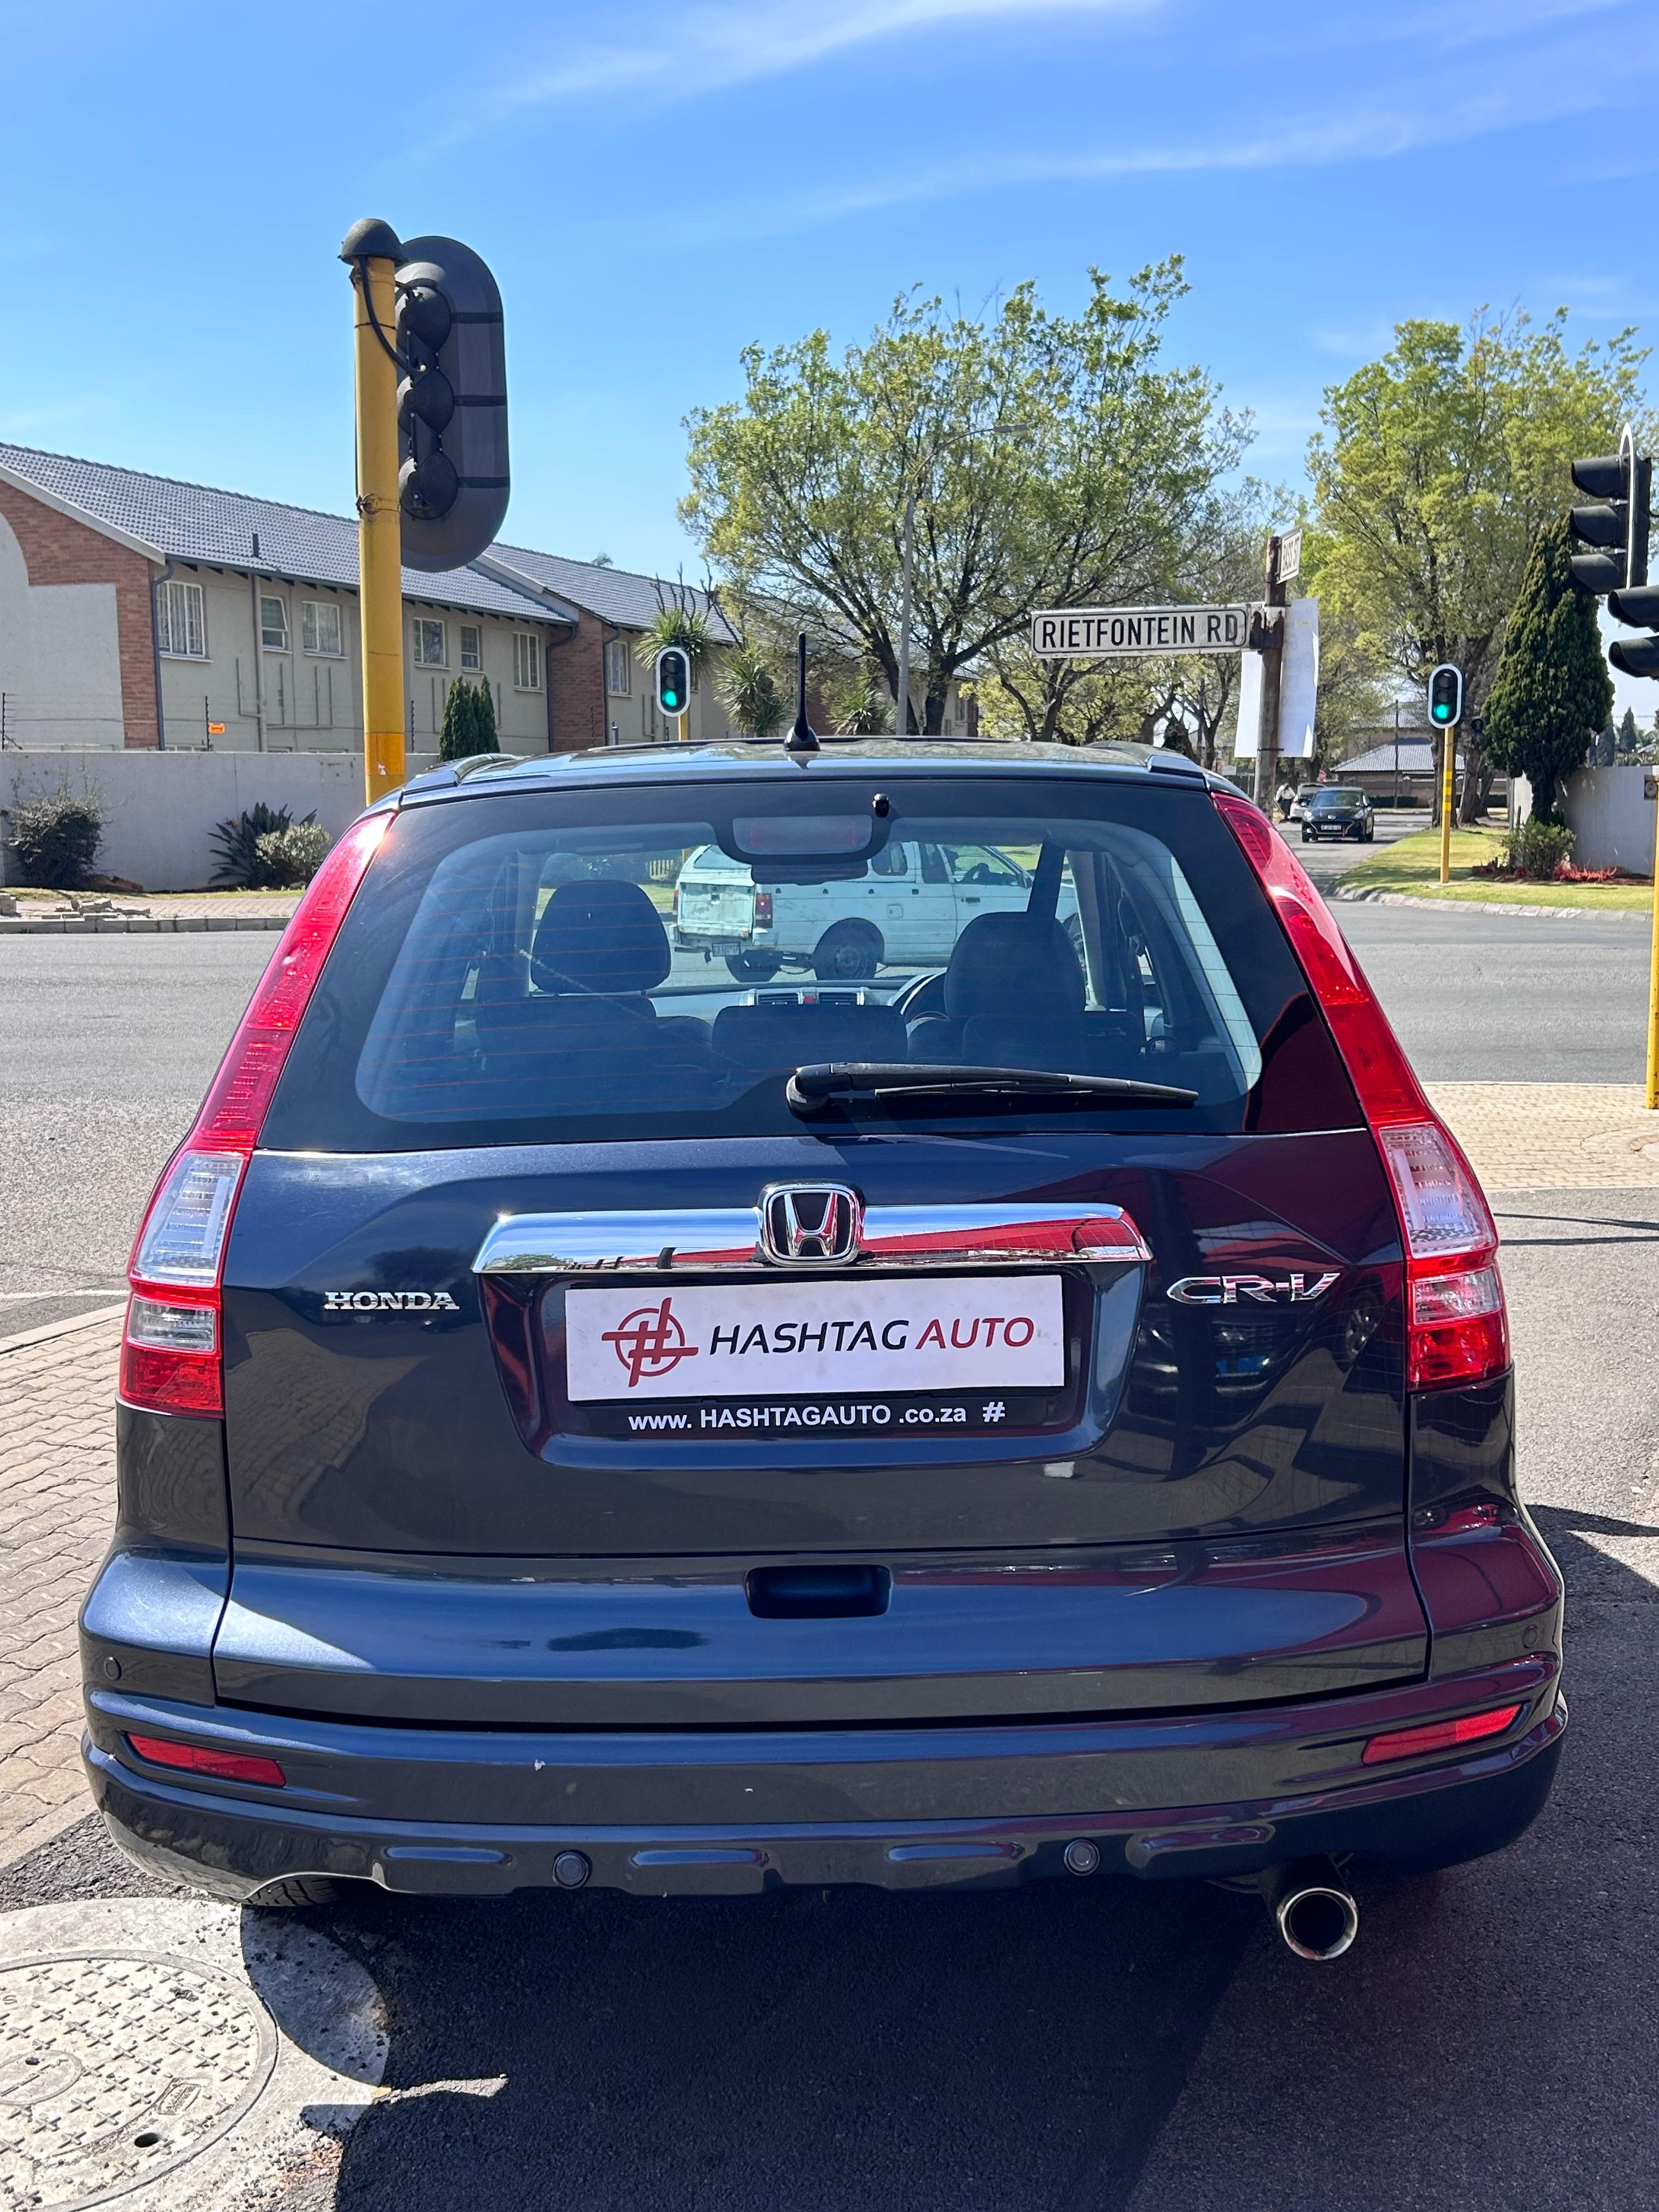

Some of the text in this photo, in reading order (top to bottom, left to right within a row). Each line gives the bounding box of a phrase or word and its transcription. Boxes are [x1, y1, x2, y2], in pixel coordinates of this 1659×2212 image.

[1042, 614, 1238, 648] RIETFONTEIN RD
[324, 1290, 460, 1311] HONDA
[1166, 1273, 1341, 1305] CR-V
[709, 1317, 1035, 1355] HASHTAG AUTO
[628, 1414, 692, 1431] www.
[701, 1404, 891, 1428] HASHTAGAUTO
[899, 1406, 967, 1424] .co.za
